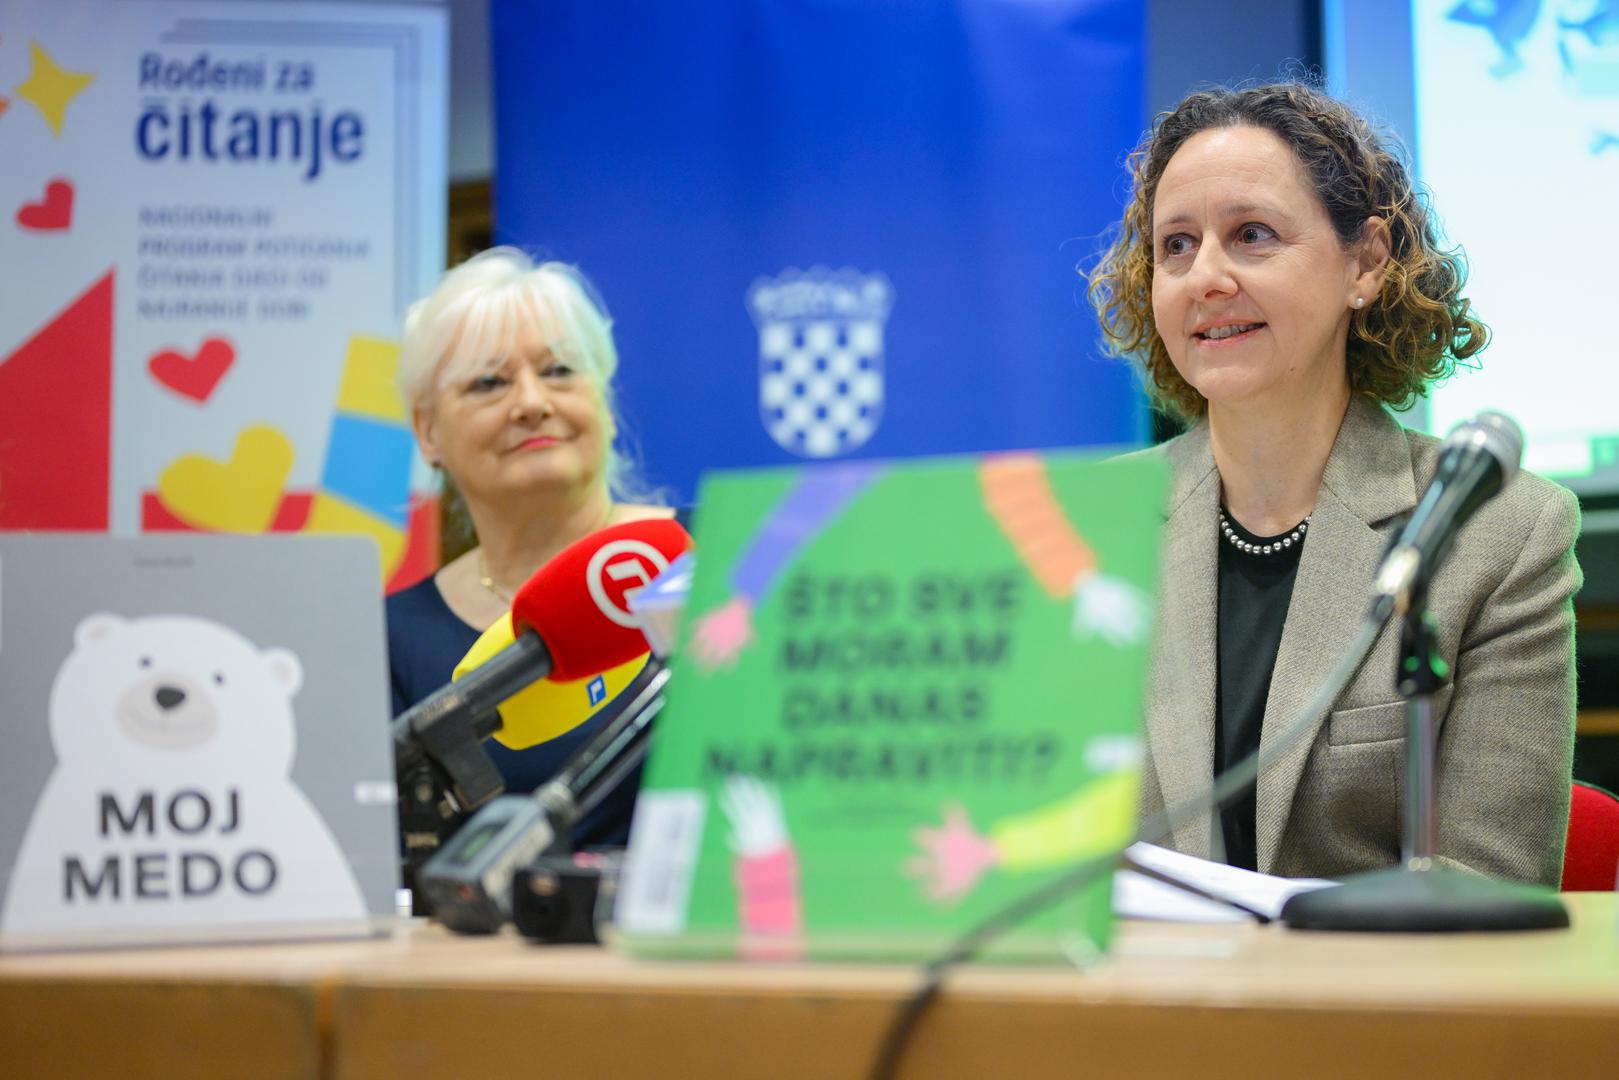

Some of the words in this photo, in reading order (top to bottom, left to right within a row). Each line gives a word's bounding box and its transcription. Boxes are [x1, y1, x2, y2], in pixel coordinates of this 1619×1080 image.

[138, 52, 264, 92] Rođeni
[275, 60, 314, 92] za
[136, 99, 366, 182] čitanje
[785, 568, 893, 622] ŠTO
[912, 572, 1022, 618] SVE
[781, 630, 1014, 674] MORAM
[781, 684, 990, 731] DANAS
[98, 788, 241, 838] MOJ
[62, 851, 278, 903] MEDO
